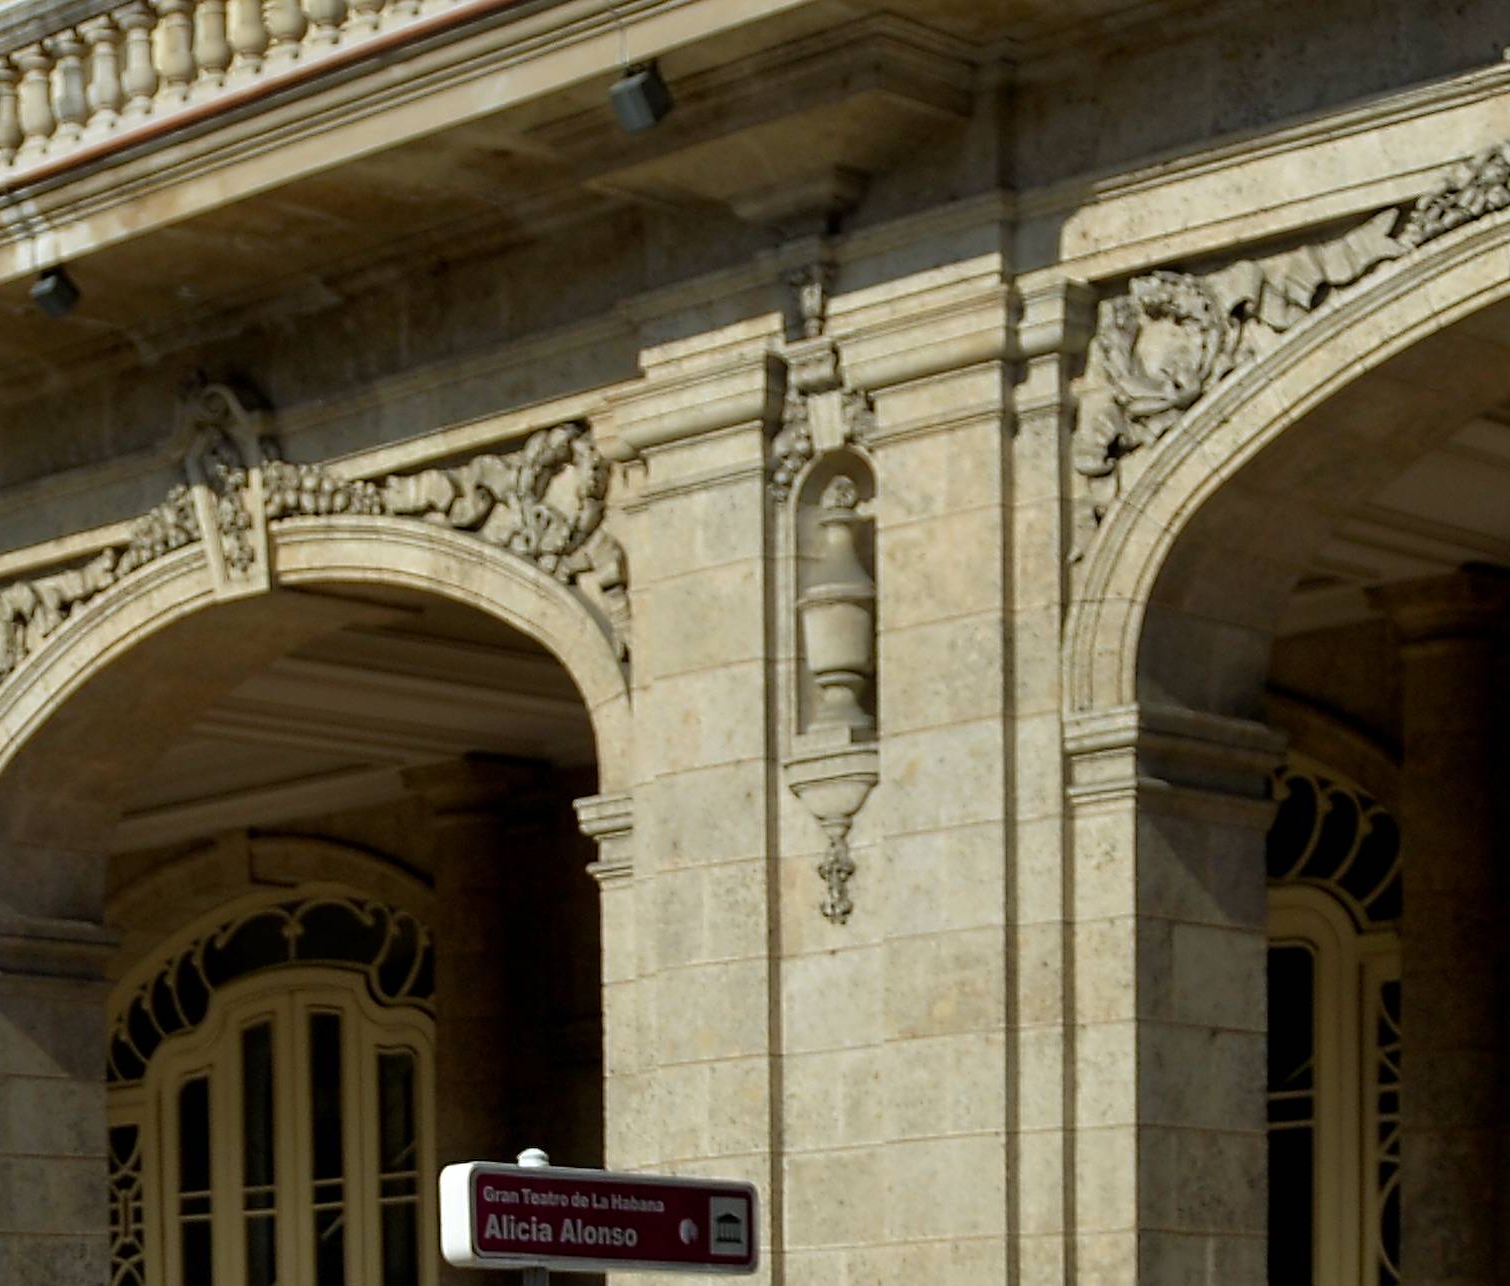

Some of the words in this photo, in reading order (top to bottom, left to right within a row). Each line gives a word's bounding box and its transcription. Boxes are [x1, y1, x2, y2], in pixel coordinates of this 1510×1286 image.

[483, 1186, 519, 1203] Gran
[521, 1188, 569, 1207] Teatro
[570, 1192, 589, 1208] de
[591, 1193, 609, 1209] La
[610, 1194, 665, 1212] Habana
[484, 1213, 553, 1242] Alicia
[560, 1218, 638, 1247] Alonso
